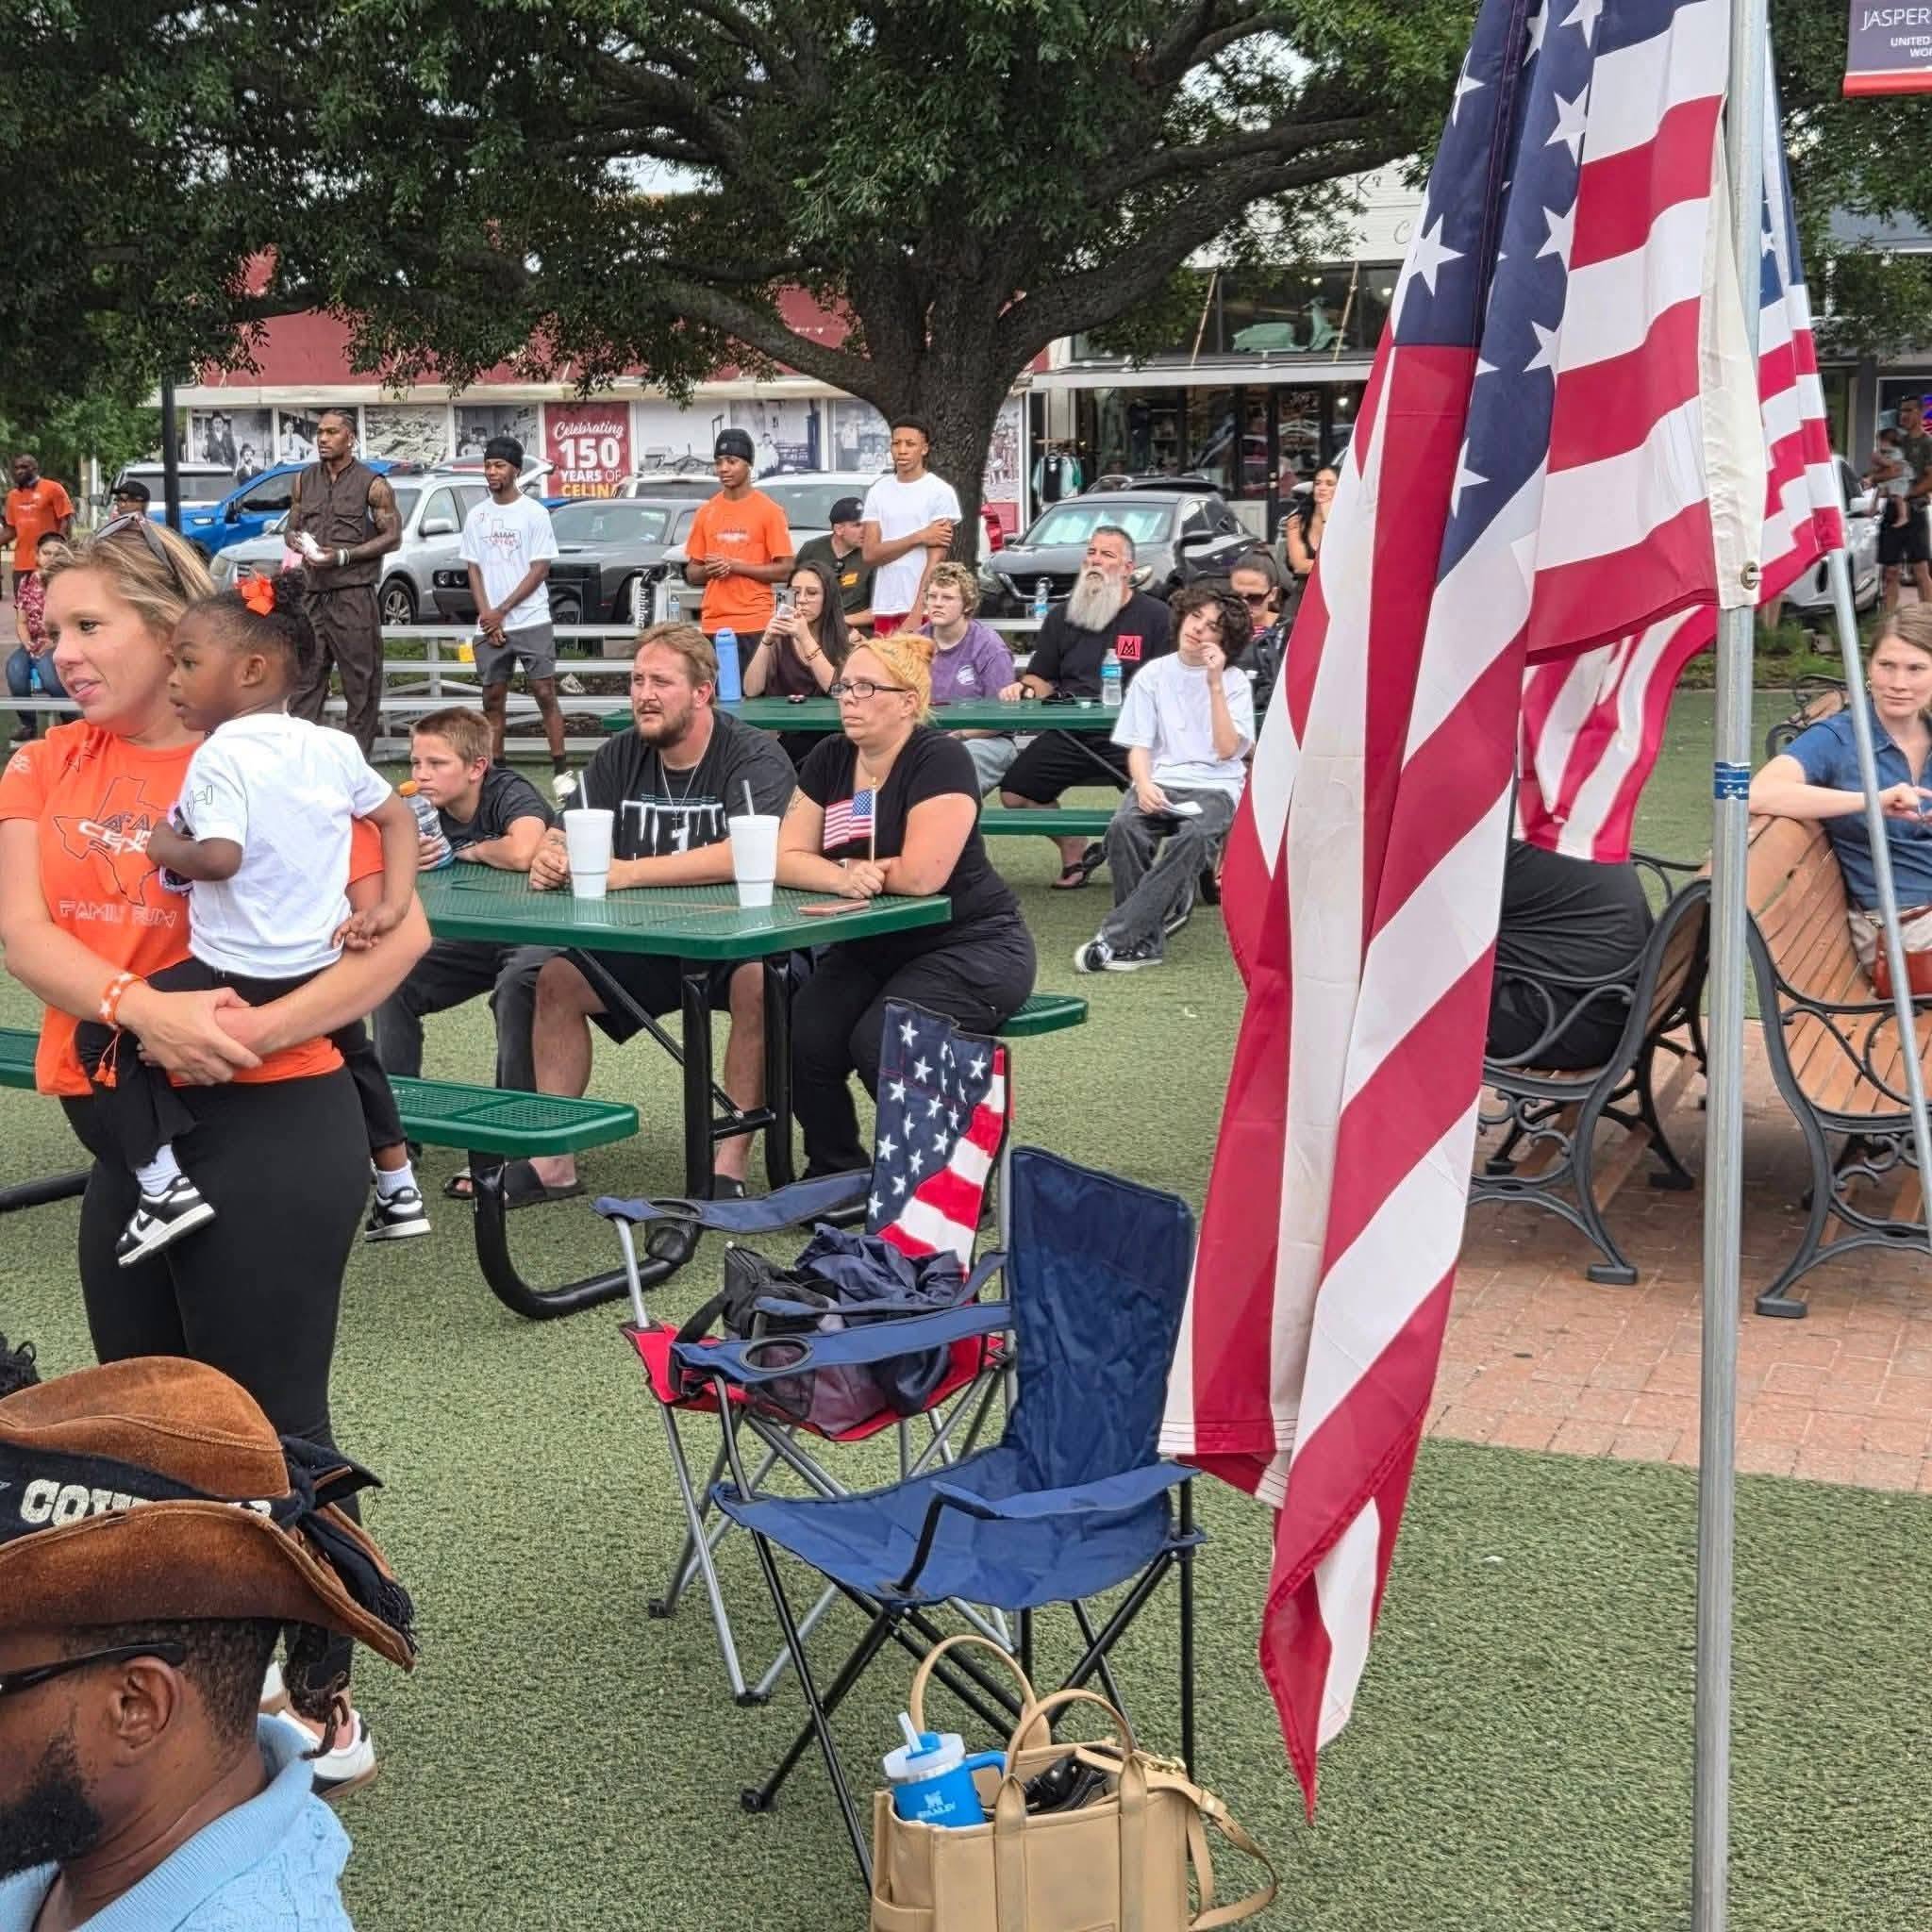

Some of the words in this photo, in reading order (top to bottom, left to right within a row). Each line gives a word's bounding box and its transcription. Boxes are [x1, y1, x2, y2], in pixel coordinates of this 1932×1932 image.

[1890, 36, 1931, 47] UNITED
[554, 421, 624, 440] Celebrating
[558, 438, 621, 469] 150
[560, 470, 602, 482] YEARS
[605, 470, 622, 482] OF
